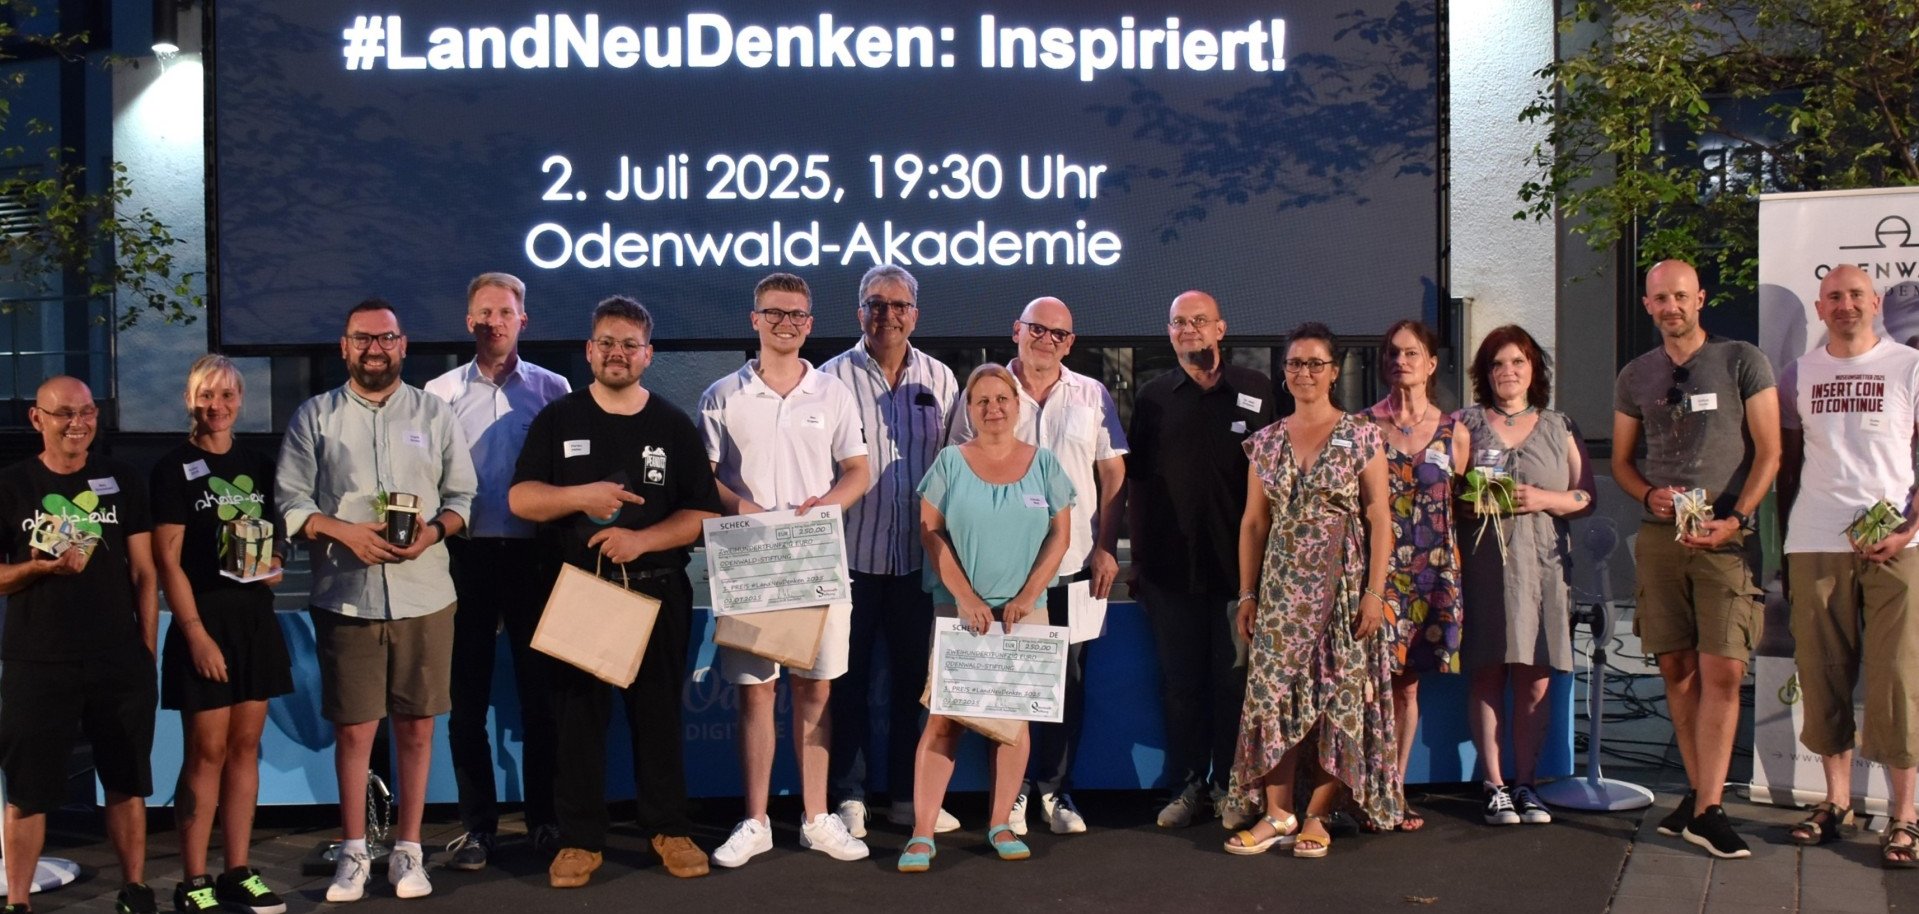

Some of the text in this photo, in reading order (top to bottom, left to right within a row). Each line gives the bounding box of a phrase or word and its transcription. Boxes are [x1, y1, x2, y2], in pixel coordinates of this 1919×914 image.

[343, 13, 1287, 82] #LandNeuDenken: Inspiriert!
[541, 153, 1108, 207] 2. Juli 2025, 19:30 Uhr
[525, 219, 1122, 269] Odenwald-Akademie
[1812, 382, 1885, 398] INSERT COIN
[1811, 398, 1884, 414] TO CONTINUE
[820, 511, 831, 519] DE
[720, 520, 750, 530] SCHECK
[720, 554, 792, 568] ODENWALD-STIFTUNG
[945, 661, 1015, 671] ODENWALD-STIFTUNG
